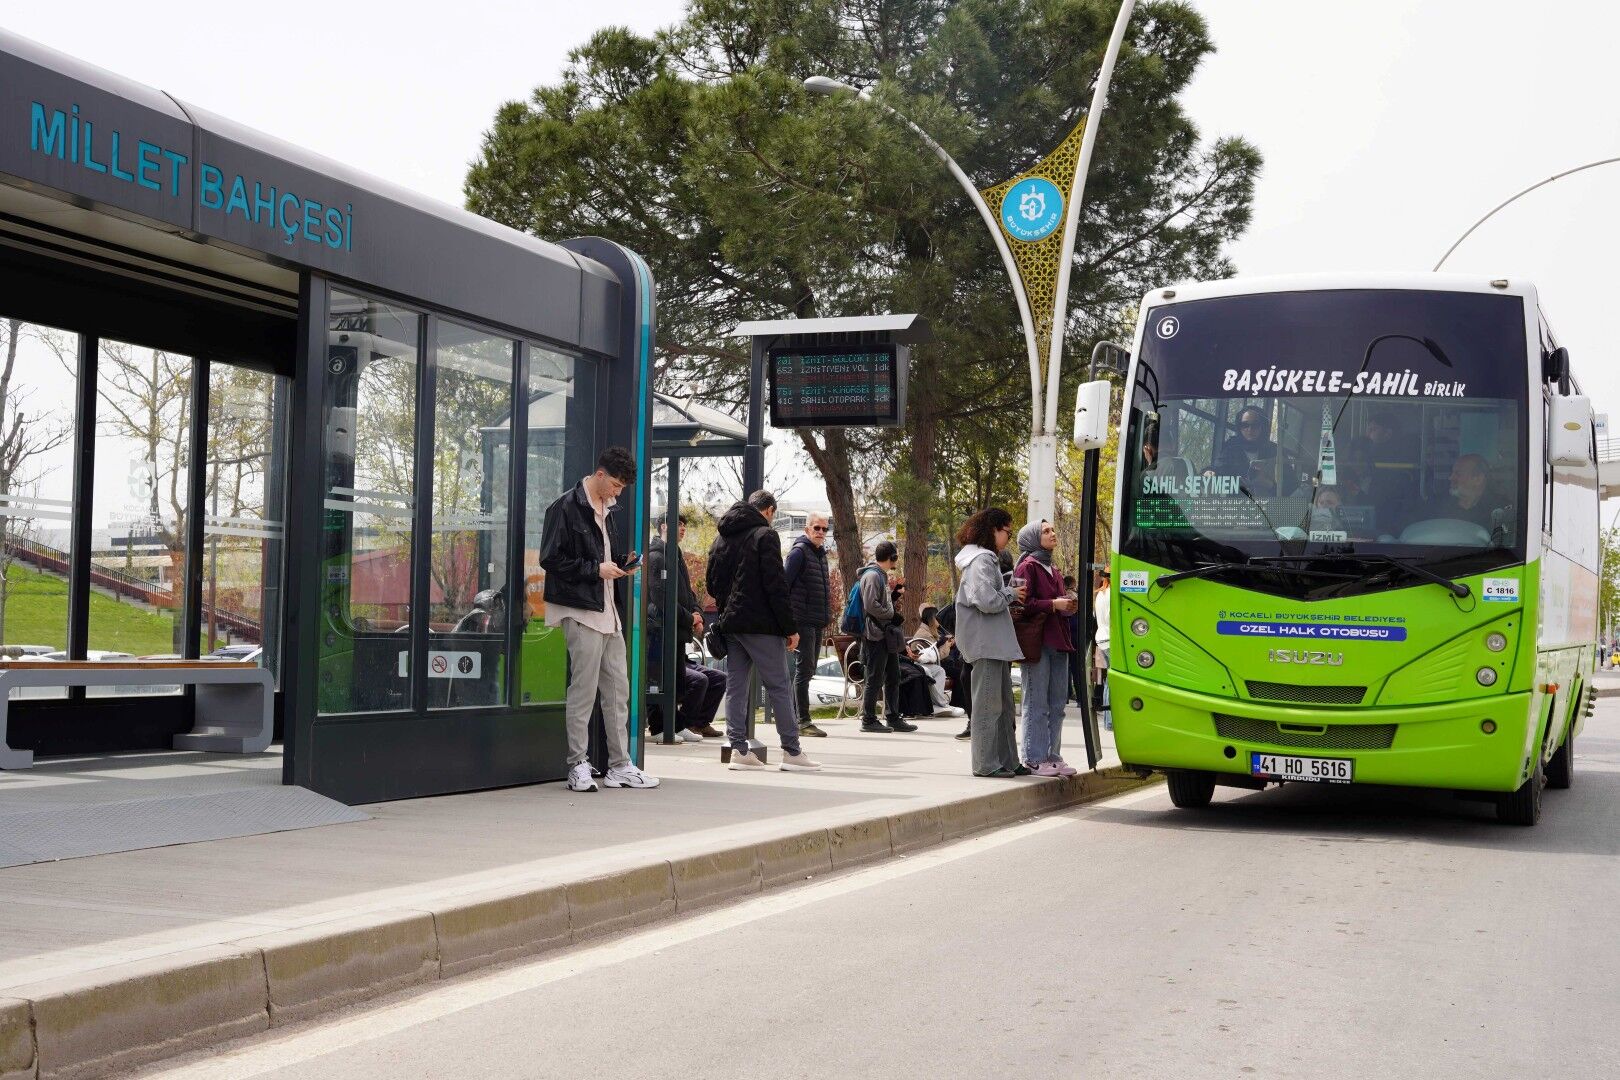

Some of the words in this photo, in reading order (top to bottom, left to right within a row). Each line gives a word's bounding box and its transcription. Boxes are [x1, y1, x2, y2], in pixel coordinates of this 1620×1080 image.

[31, 101, 188, 197] MİLLET
[200, 163, 353, 252] BAHÇESİ
[1161, 319, 1173, 336] 6
[1222, 365, 1419, 396] BAŞİSKELE-SAHİL
[1424, 380, 1466, 397] BİRLİK
[1312, 534, 1342, 542] İZMİT
[1229, 611, 1272, 619] KOCAELİ
[1275, 613, 1340, 621] BÜYÜKŞEHİR
[1344, 615, 1406, 623] BELEDİYESİ
[1239, 624, 1276, 634] ÖZEL
[1279, 626, 1316, 636] HALK
[1320, 627, 1389, 638] OTOBÜSÜ
[1269, 649, 1343, 666] ISUZU
[1262, 757, 1275, 773] 41
[1311, 760, 1346, 777] 5616
